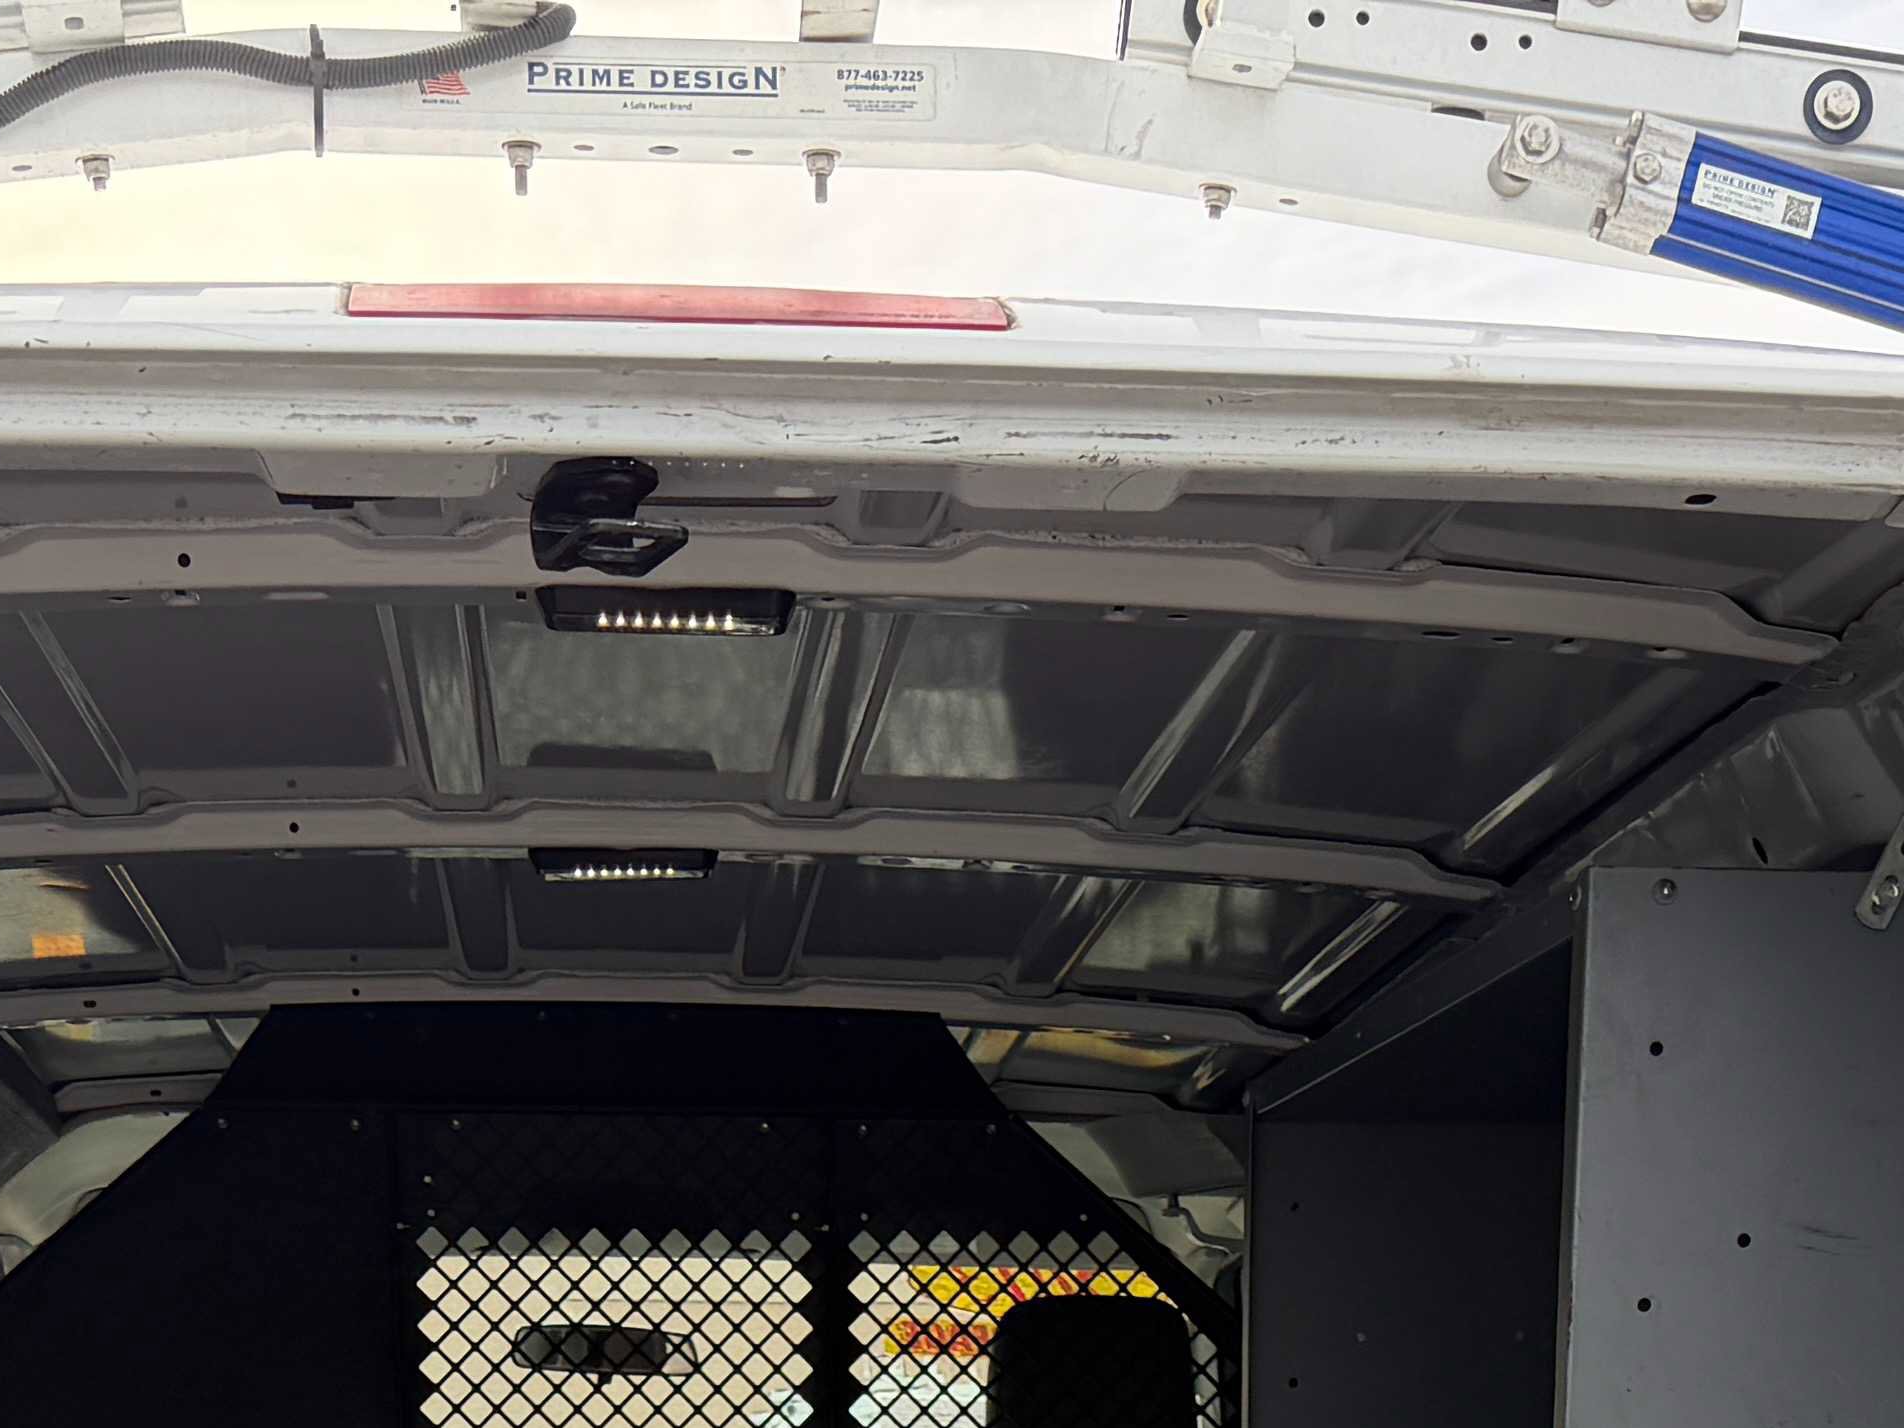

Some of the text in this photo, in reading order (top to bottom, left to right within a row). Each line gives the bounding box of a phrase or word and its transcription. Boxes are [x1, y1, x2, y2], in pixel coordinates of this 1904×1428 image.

[527, 62, 779, 91] PRIME DESIGN
[836, 69, 924, 82] 877-463-7225
